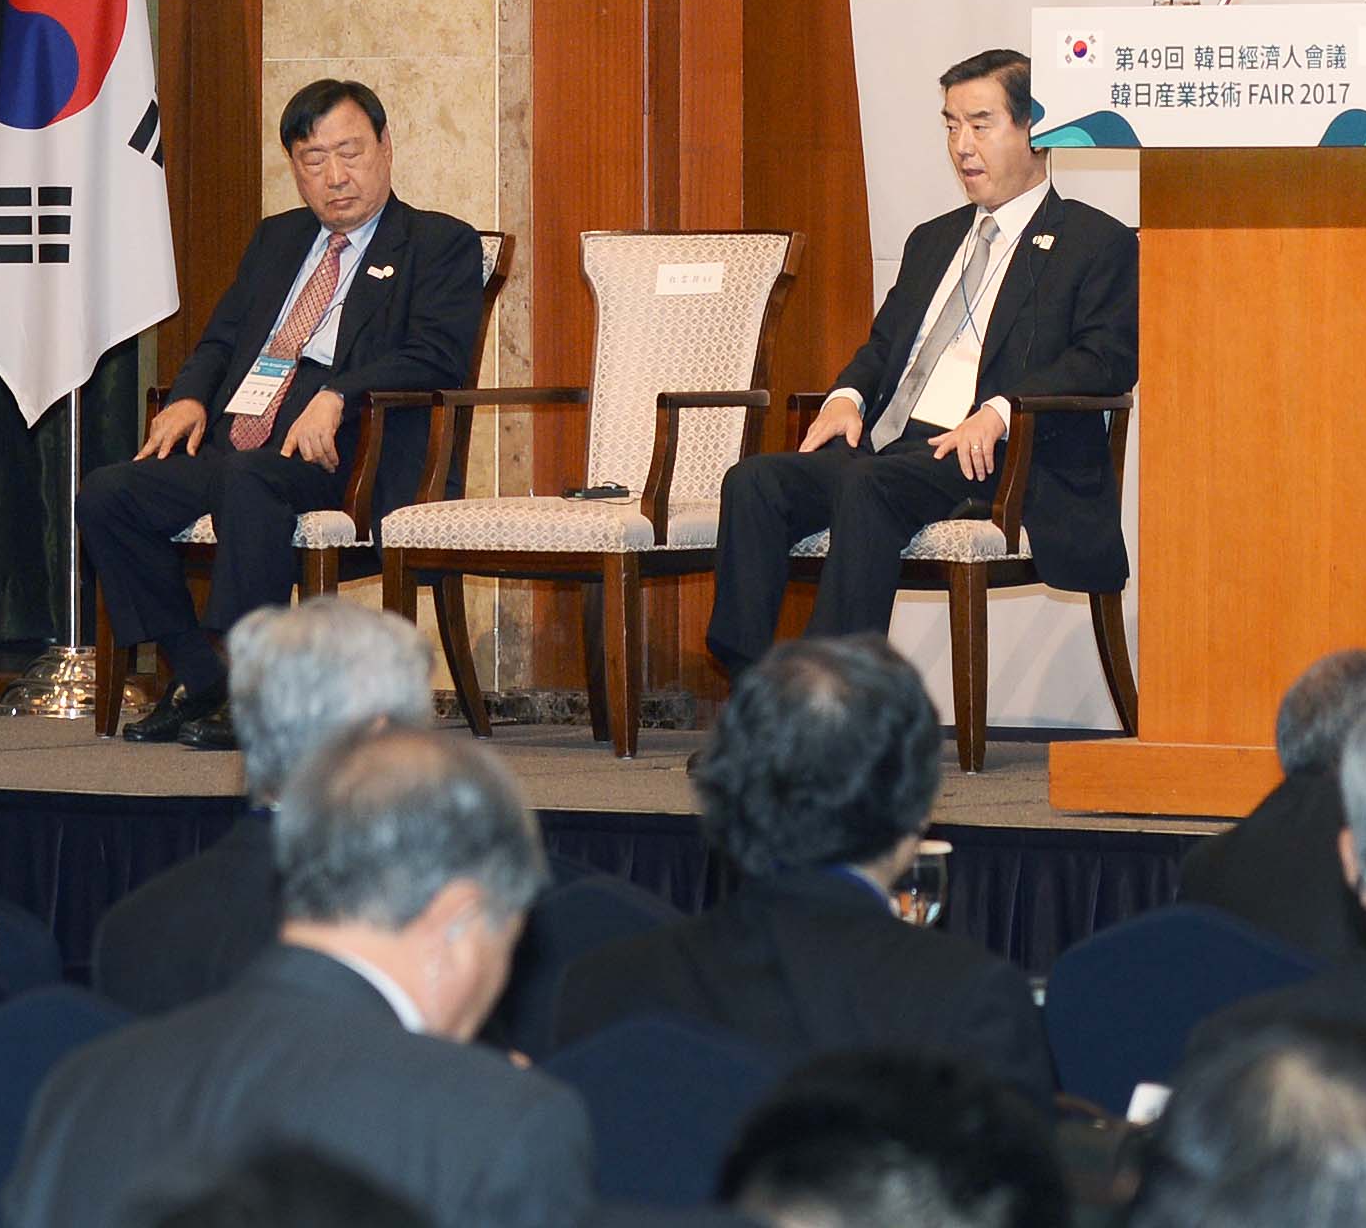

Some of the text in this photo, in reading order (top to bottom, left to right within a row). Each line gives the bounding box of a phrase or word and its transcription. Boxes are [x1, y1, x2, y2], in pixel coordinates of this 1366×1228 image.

[1114, 44, 1346, 71] 第49回 韓日經濟人會議
[1110, 81, 1351, 108] 韓日産業技術 FAIR 2017
